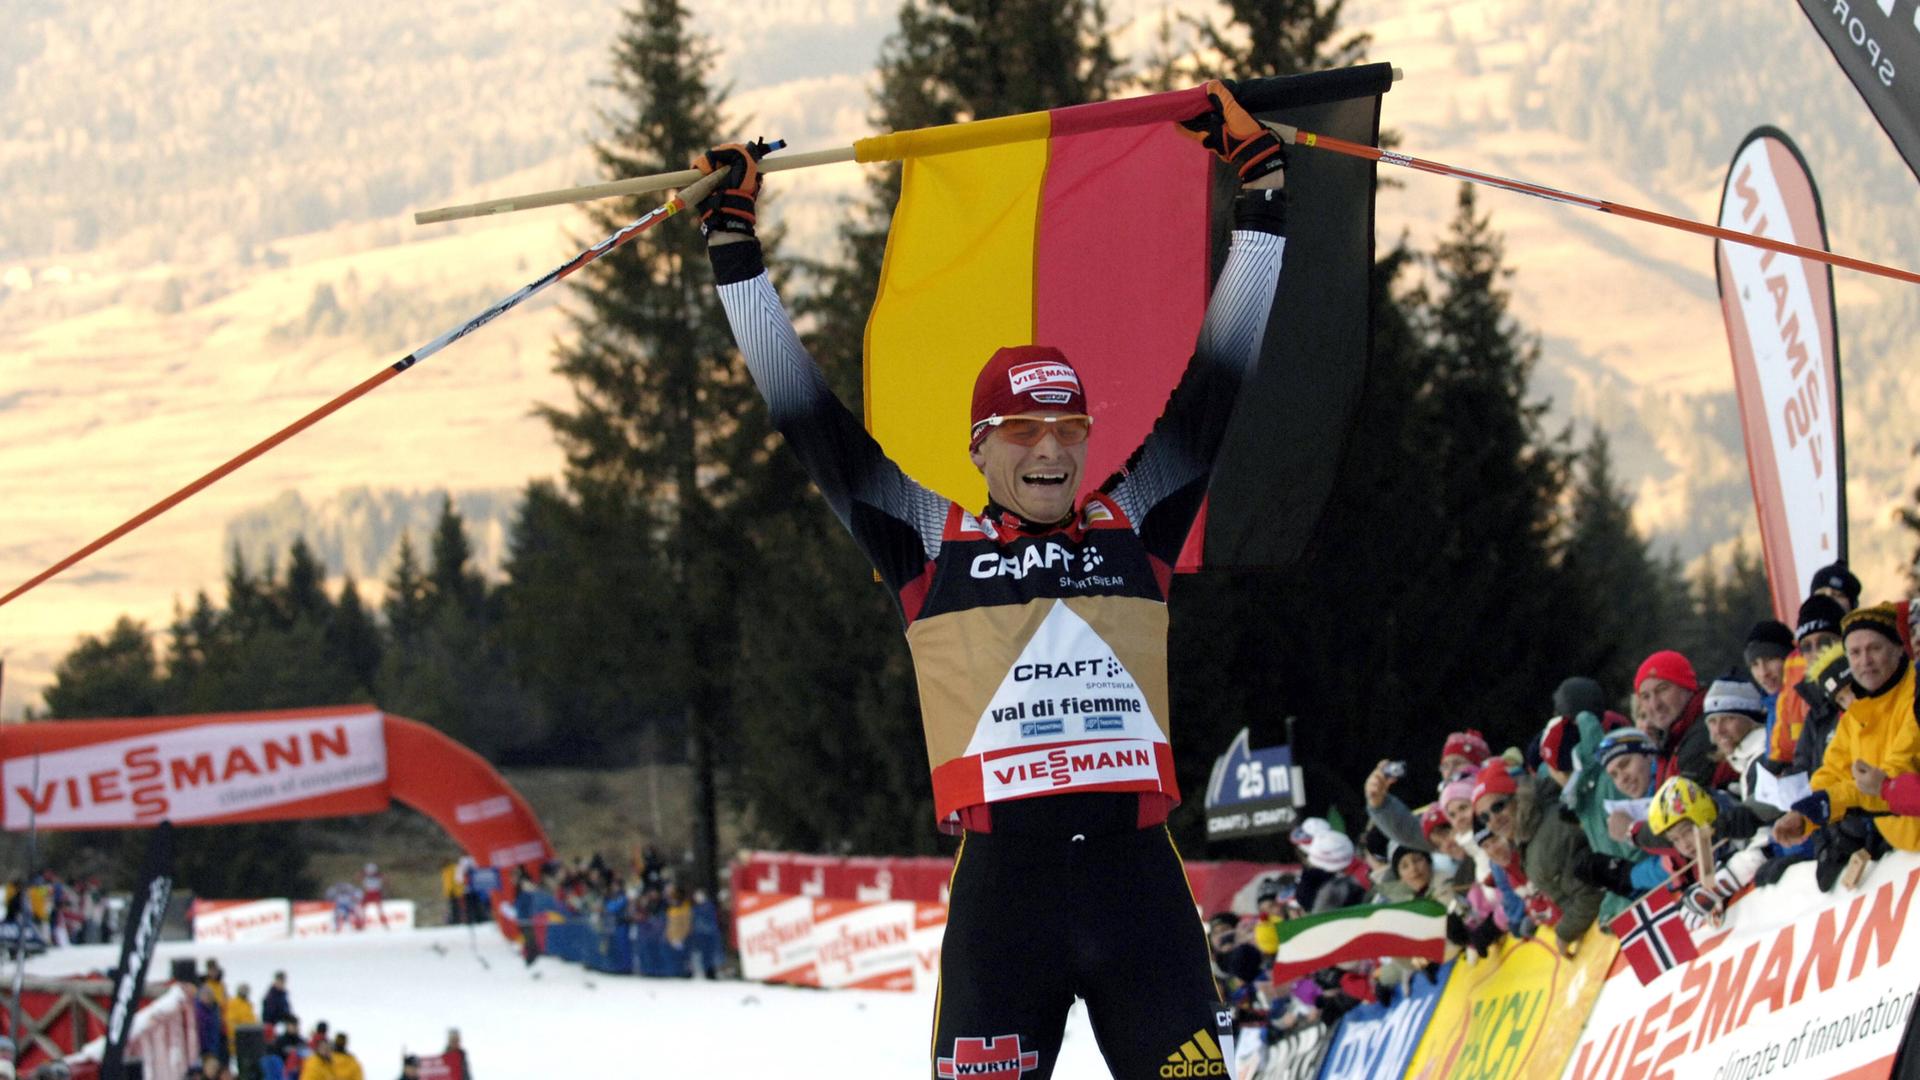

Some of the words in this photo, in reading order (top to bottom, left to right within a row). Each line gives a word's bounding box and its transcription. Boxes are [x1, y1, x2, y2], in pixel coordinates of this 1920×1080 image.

[970, 542, 1074, 579] CRAFT
[1014, 659, 1103, 681] CRAFT
[1086, 681, 1135, 690] SPORTSWEAR
[992, 702, 1025, 723] val
[1032, 699, 1055, 717] di
[1061, 697, 1141, 714] fiemme
[16, 726, 349, 820] VIESSMANN
[994, 750, 1149, 786] VIESSMANN
[1236, 761, 1265, 799] 25
[1267, 765, 1290, 794] m
[1714, 1041, 1781, 1080] climate
[1782, 1020, 1811, 1069] of
[1804, 987, 1914, 1060] innovation
